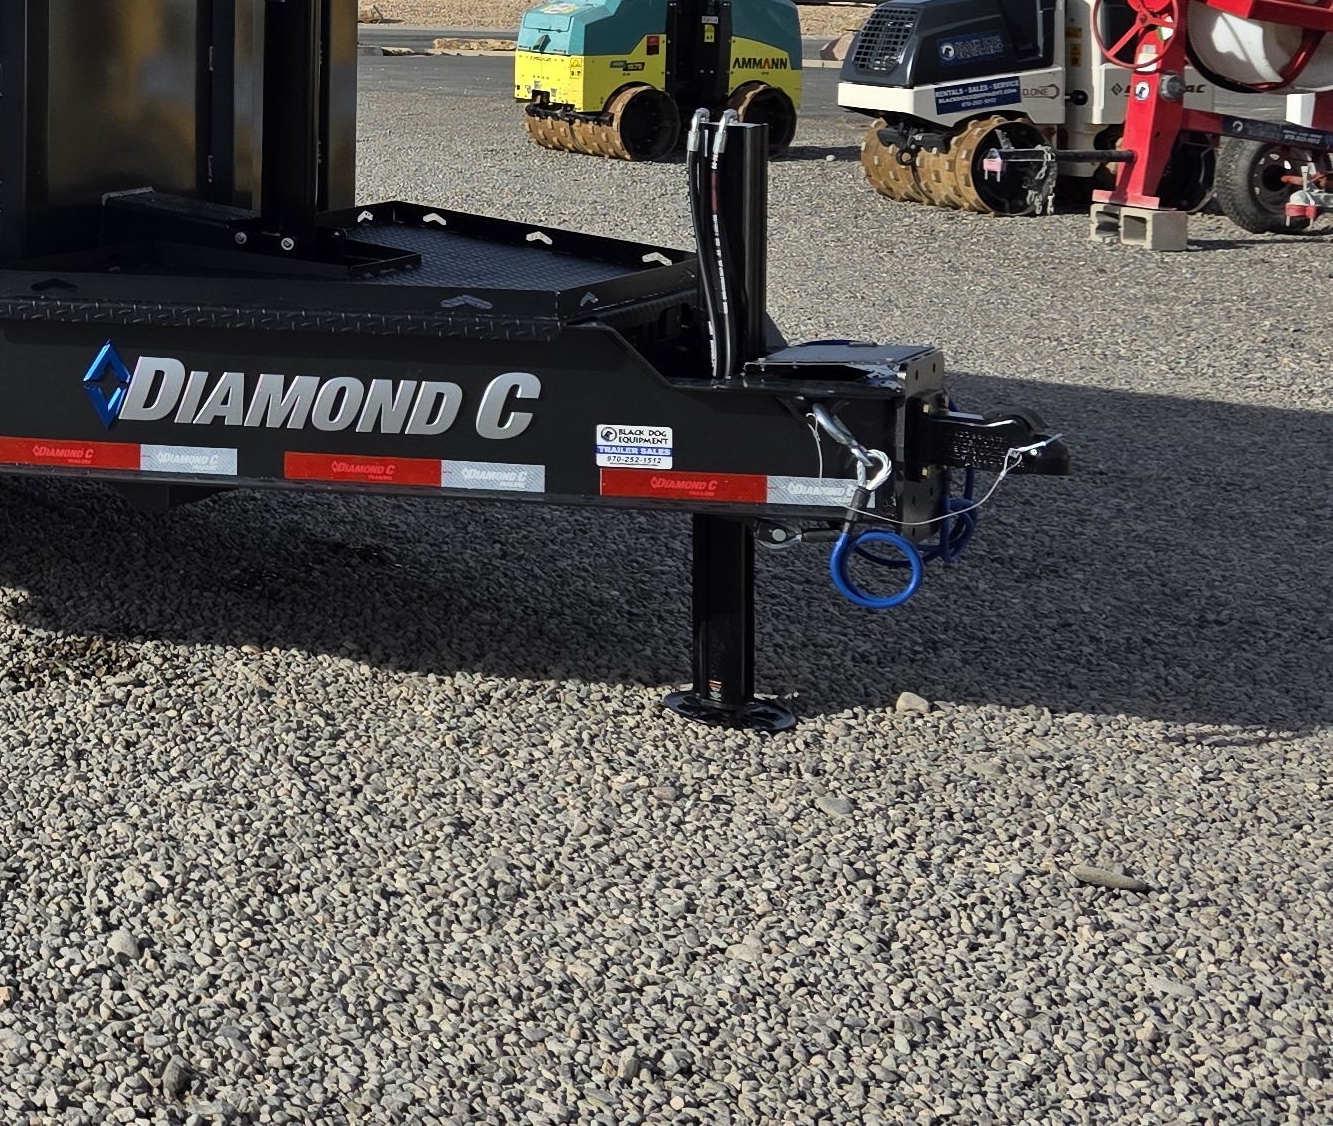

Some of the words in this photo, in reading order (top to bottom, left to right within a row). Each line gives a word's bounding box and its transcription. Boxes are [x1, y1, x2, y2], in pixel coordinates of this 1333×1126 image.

[733, 58, 788, 70] AMMANN
[118, 356, 463, 435] DIAMOND
[475, 372, 542, 440] C
[39, 446, 84, 458] DIAMOND
[85, 449, 93, 458] C
[598, 446, 638, 454] TRAILER
[607, 456, 662, 464] 970-252-1512
[336, 462, 384, 474] DIAMOND
[386, 465, 396, 474] C
[656, 478, 707, 490] DIAMOND
[708, 480, 718, 490] C
